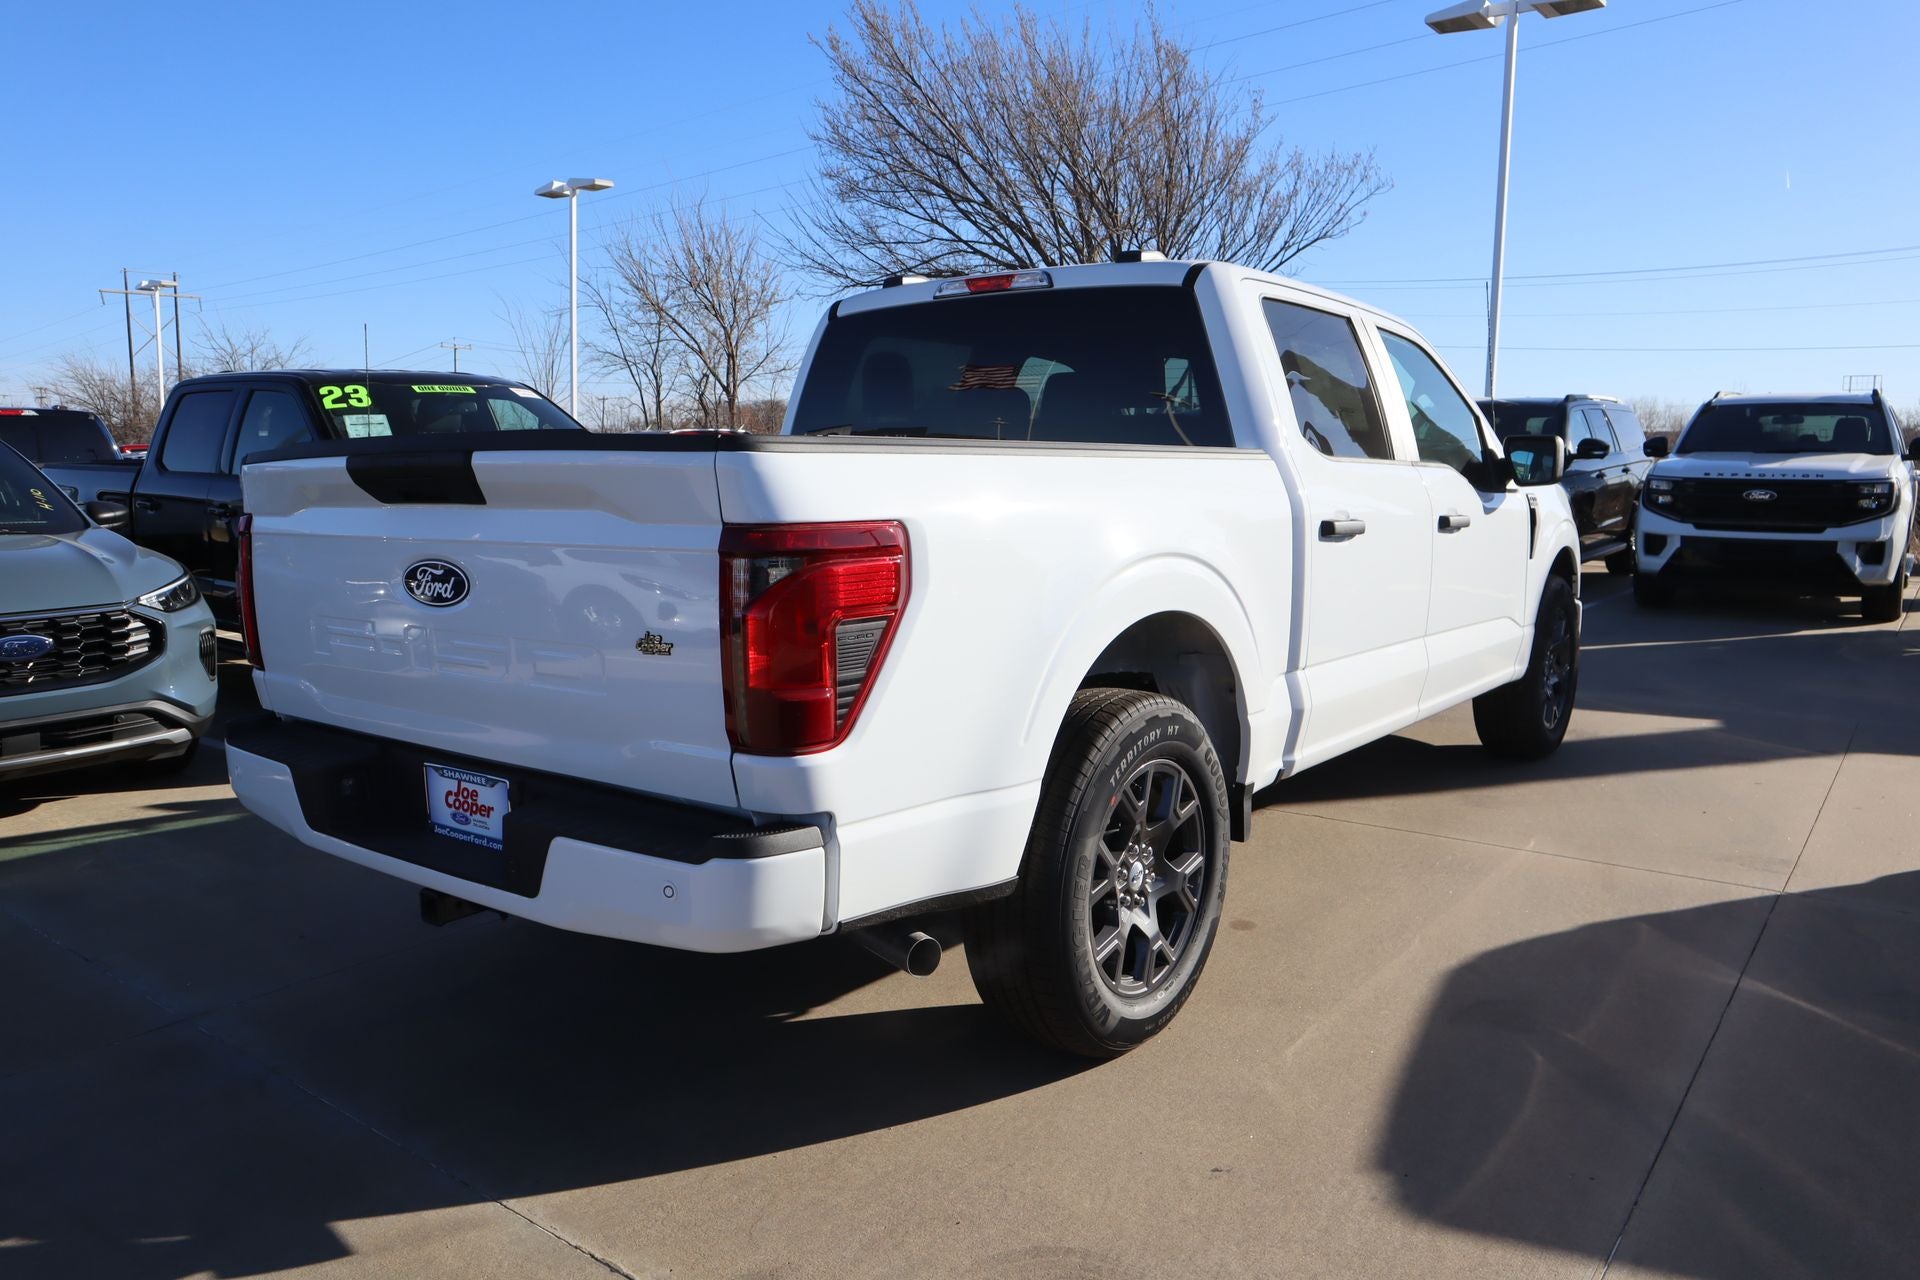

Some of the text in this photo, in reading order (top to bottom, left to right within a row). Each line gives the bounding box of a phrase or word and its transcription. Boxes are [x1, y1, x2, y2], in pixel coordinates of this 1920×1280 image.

[319, 384, 372, 410] 23
[413, 566, 455, 599] Ford
[837, 632, 874, 641] FORD
[1109, 724, 1180, 788] TERRITORY HT
[442, 769, 487, 785] SHAWNEE
[453, 779, 479, 801] Joe
[445, 789, 494, 819] Cooper
